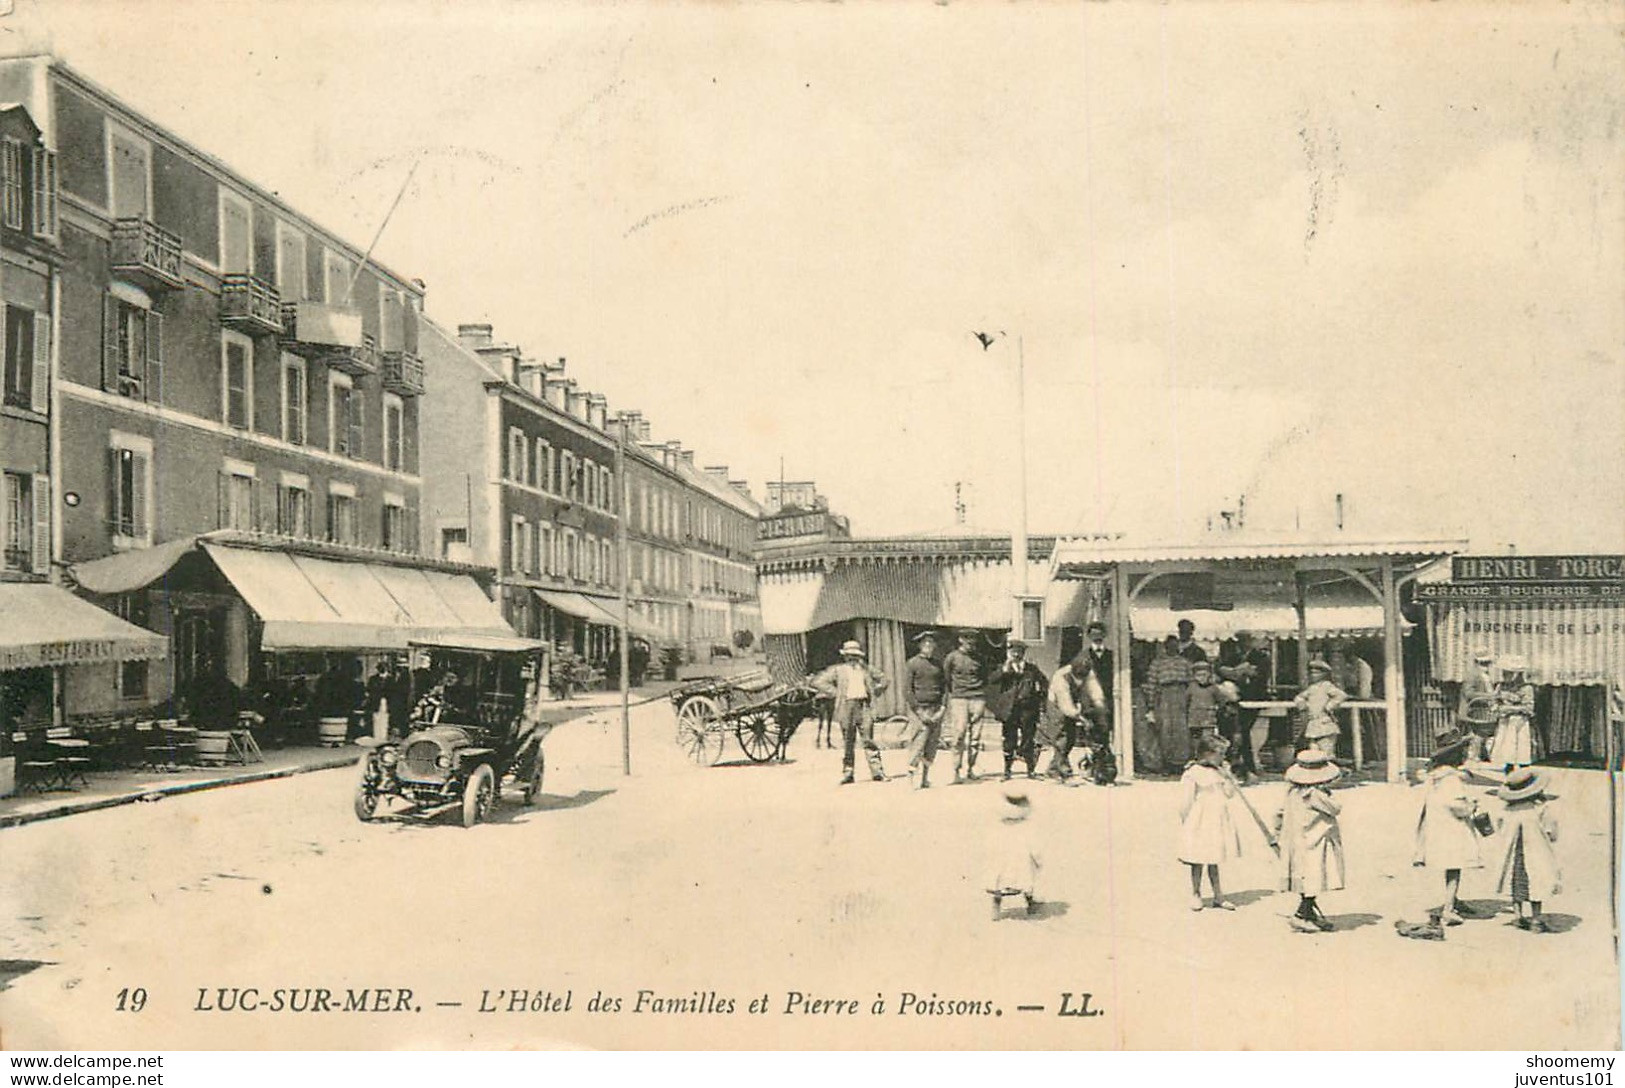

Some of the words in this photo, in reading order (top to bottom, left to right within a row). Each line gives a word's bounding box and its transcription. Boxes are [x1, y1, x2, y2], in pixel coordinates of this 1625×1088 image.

[1461, 559, 1536, 578] HENRI
[1424, 586, 1490, 596] GRANDE
[1499, 585, 1590, 596] BOUCHERIE
[1463, 622, 1548, 635] BOUCHERIE
[1557, 623, 1575, 635] DE
[1583, 623, 1601, 635] LA
[40, 640, 117, 662] RESTAURANT
